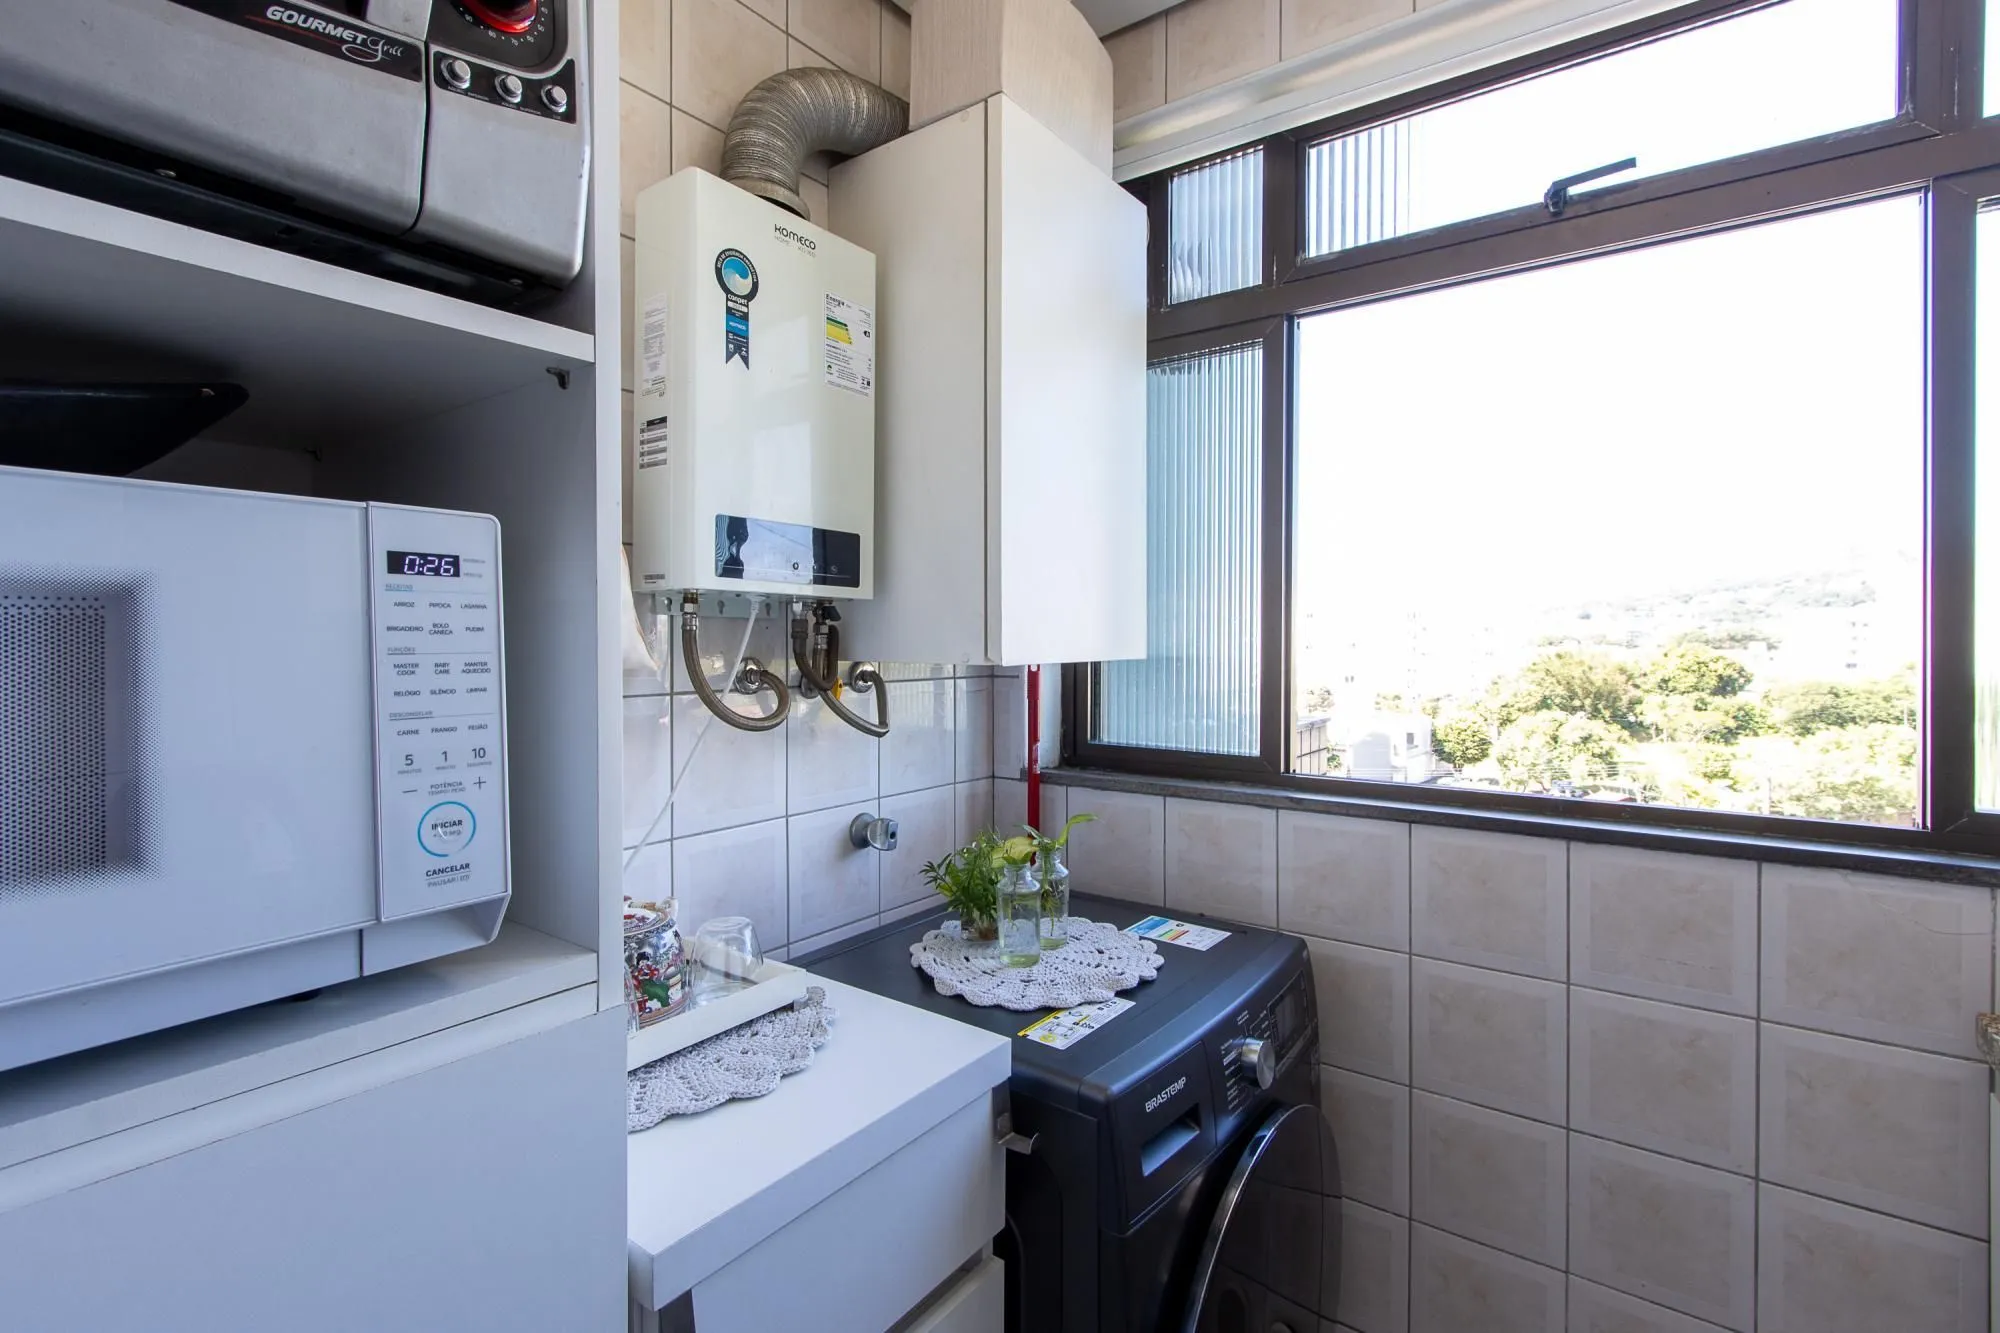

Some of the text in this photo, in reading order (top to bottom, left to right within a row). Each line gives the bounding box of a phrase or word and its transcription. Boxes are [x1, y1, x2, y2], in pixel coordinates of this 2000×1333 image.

[266, 5, 368, 45] GOURMET
[774, 223, 817, 251] KOMECO
[403, 555, 455, 576] 0:26
[386, 625, 424, 633] BRIGADEIRO
[393, 689, 421, 697] RELÓGIO
[429, 687, 457, 696] SILÊNCIO
[431, 726, 458, 734] FRANGO
[468, 723, 488, 731] FEIJÃO
[441, 751, 448, 762] 1
[471, 747, 486, 759] 10
[404, 754, 414, 767] 5
[430, 780, 463, 790] POTÊNCIA
[425, 862, 470, 877] CANCELAR
[1145, 1076, 1187, 1112] BRASTEMP
